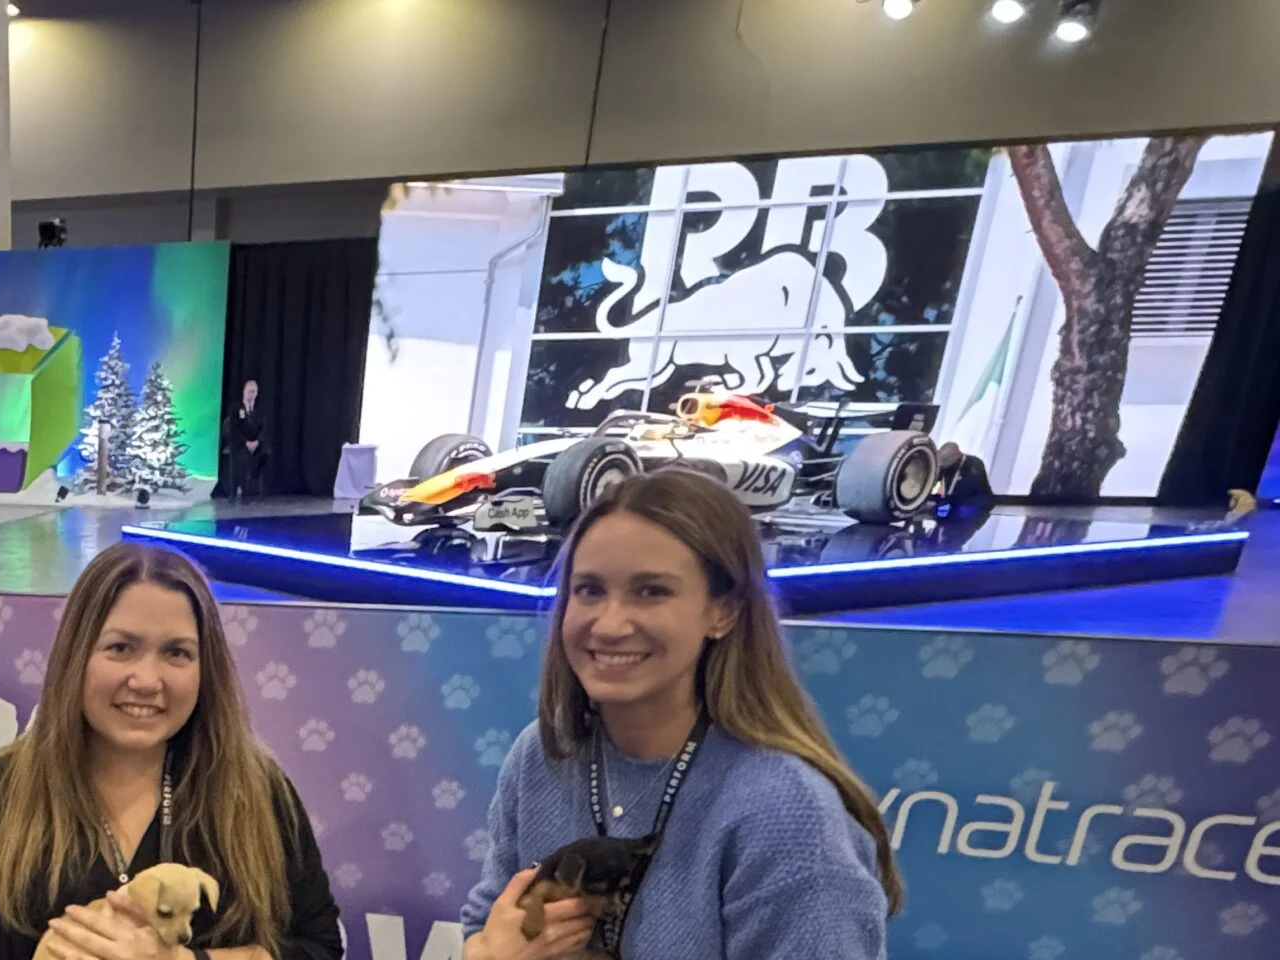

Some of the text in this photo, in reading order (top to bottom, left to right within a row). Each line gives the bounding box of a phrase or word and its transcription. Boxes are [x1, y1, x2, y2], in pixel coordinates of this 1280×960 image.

[732, 460, 788, 498] VISA
[488, 506, 530, 520] Cash App
